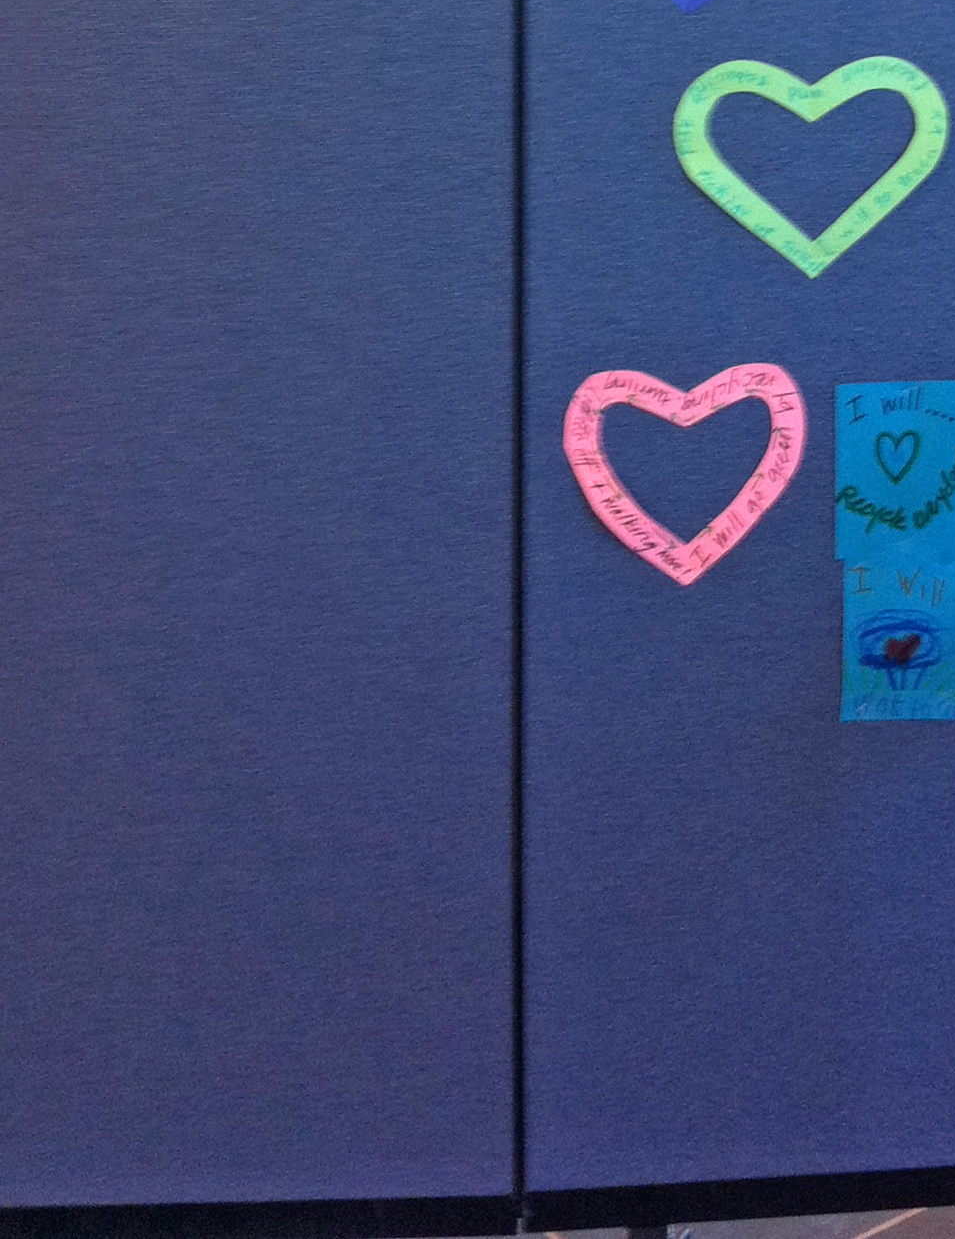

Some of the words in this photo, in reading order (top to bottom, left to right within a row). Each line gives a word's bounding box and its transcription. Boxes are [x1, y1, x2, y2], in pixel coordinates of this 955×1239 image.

[844, 394, 868, 425] I
[689, 545, 712, 567] I
[712, 511, 744, 548] will
[768, 427, 792, 483] green
[600, 495, 657, 554] walking
[847, 564, 873, 595] I
